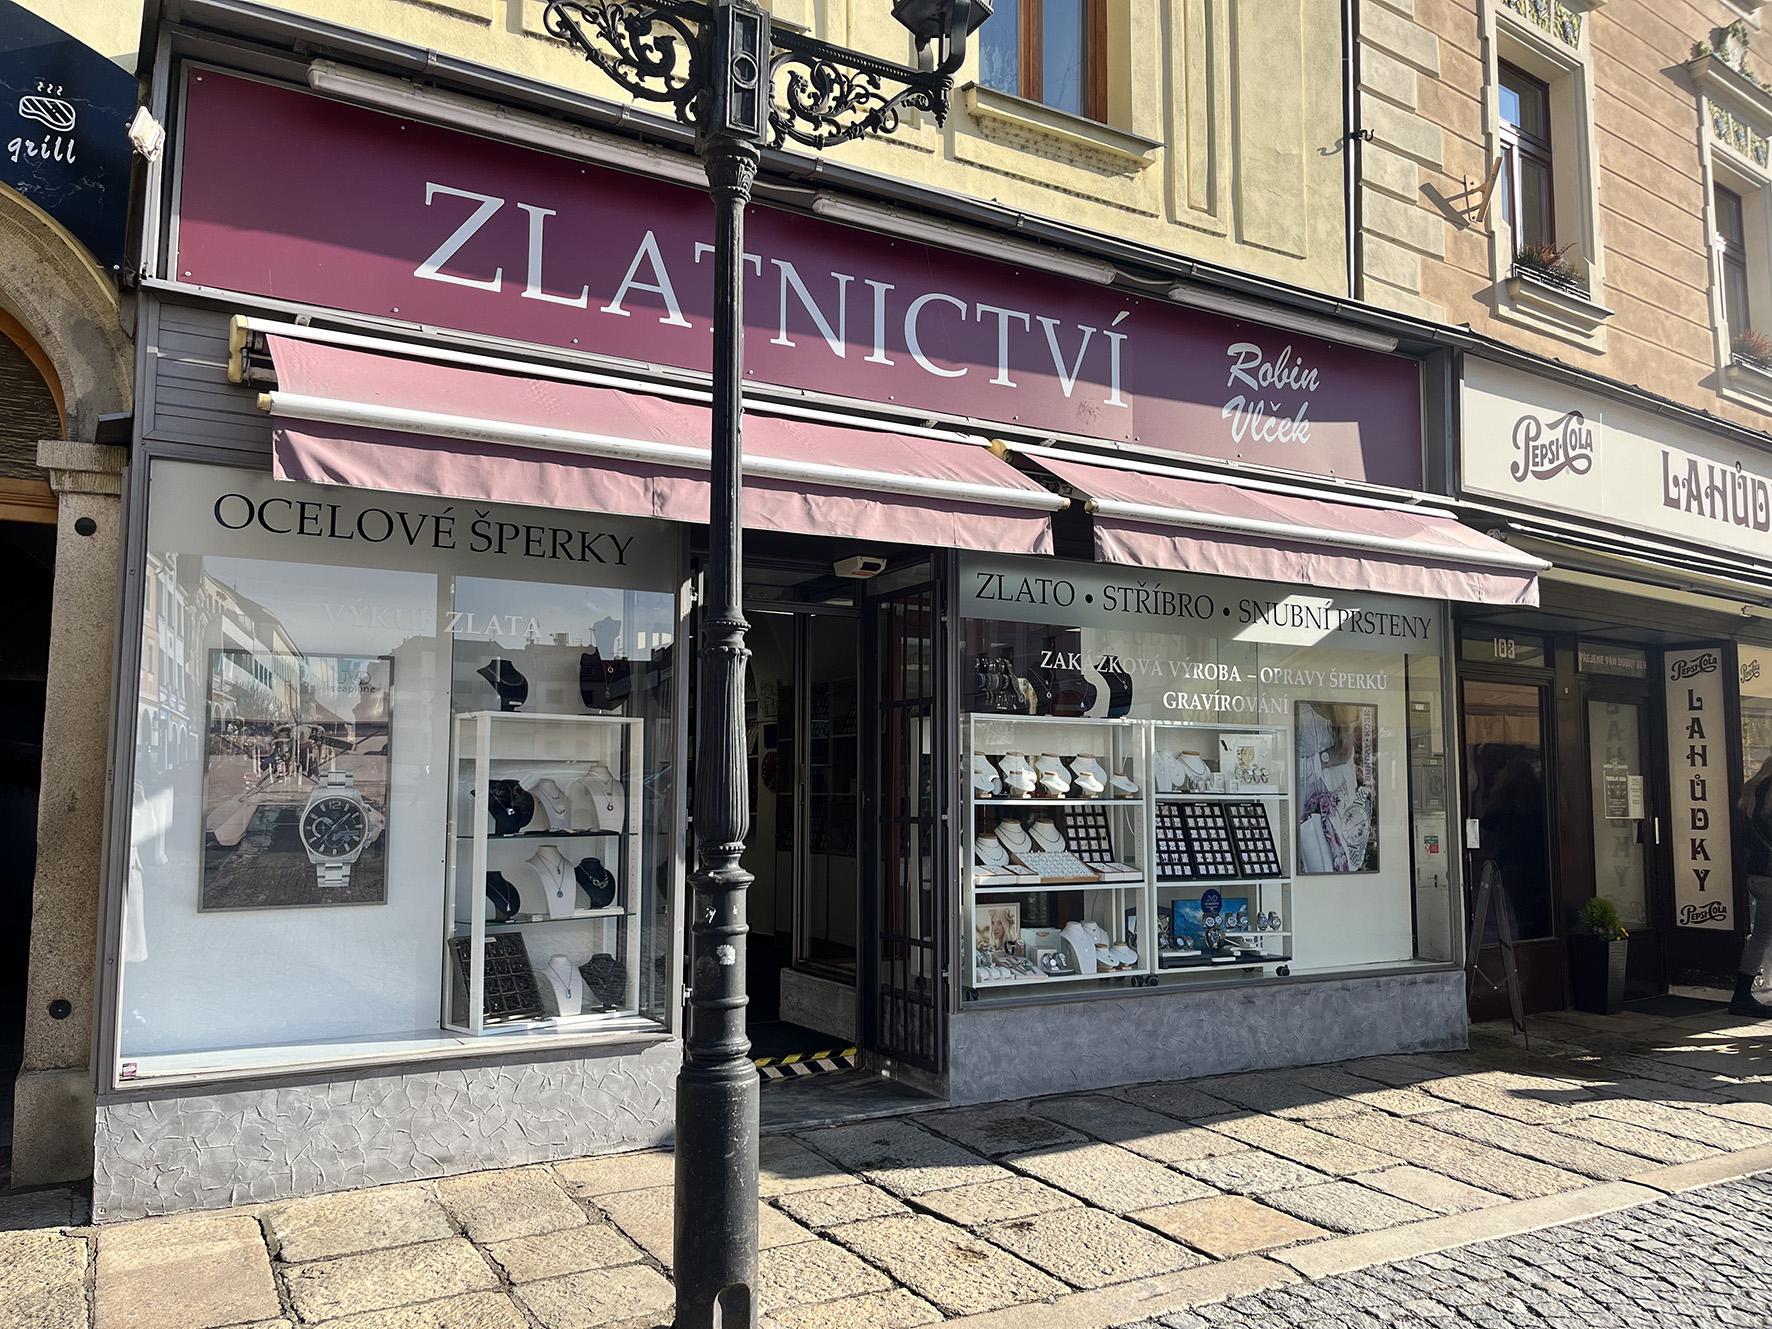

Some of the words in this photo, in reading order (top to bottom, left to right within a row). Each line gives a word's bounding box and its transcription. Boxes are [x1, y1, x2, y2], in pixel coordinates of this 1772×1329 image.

[7, 134, 77, 164] grill
[1226, 342, 1320, 392] Robin
[1221, 394, 1312, 444] Vlček
[213, 492, 457, 550] OCELOVÉ
[469, 508, 635, 567] ŠPERKY
[444, 611, 543, 638] ZLATA
[975, 572, 1076, 607] ZLATO
[1102, 580, 1215, 620] STŘÍBRO
[1238, 599, 1332, 630] SNUBNÍ
[1335, 608, 1432, 640] PRSTENY
[1040, 648, 1164, 677] ZAKÁZKOVÁ
[1167, 657, 1242, 682] VÝROBA
[1260, 667, 1326, 688] OPRAVY
[1329, 667, 1387, 690] ŠPERKŮ
[1493, 637, 1515, 659] 103
[1163, 689, 1289, 714] GRAVÍROVÁNÍ
[1363, 709, 1372, 737] ROSE
[1686, 689, 1711, 892] LAHŮDKY
